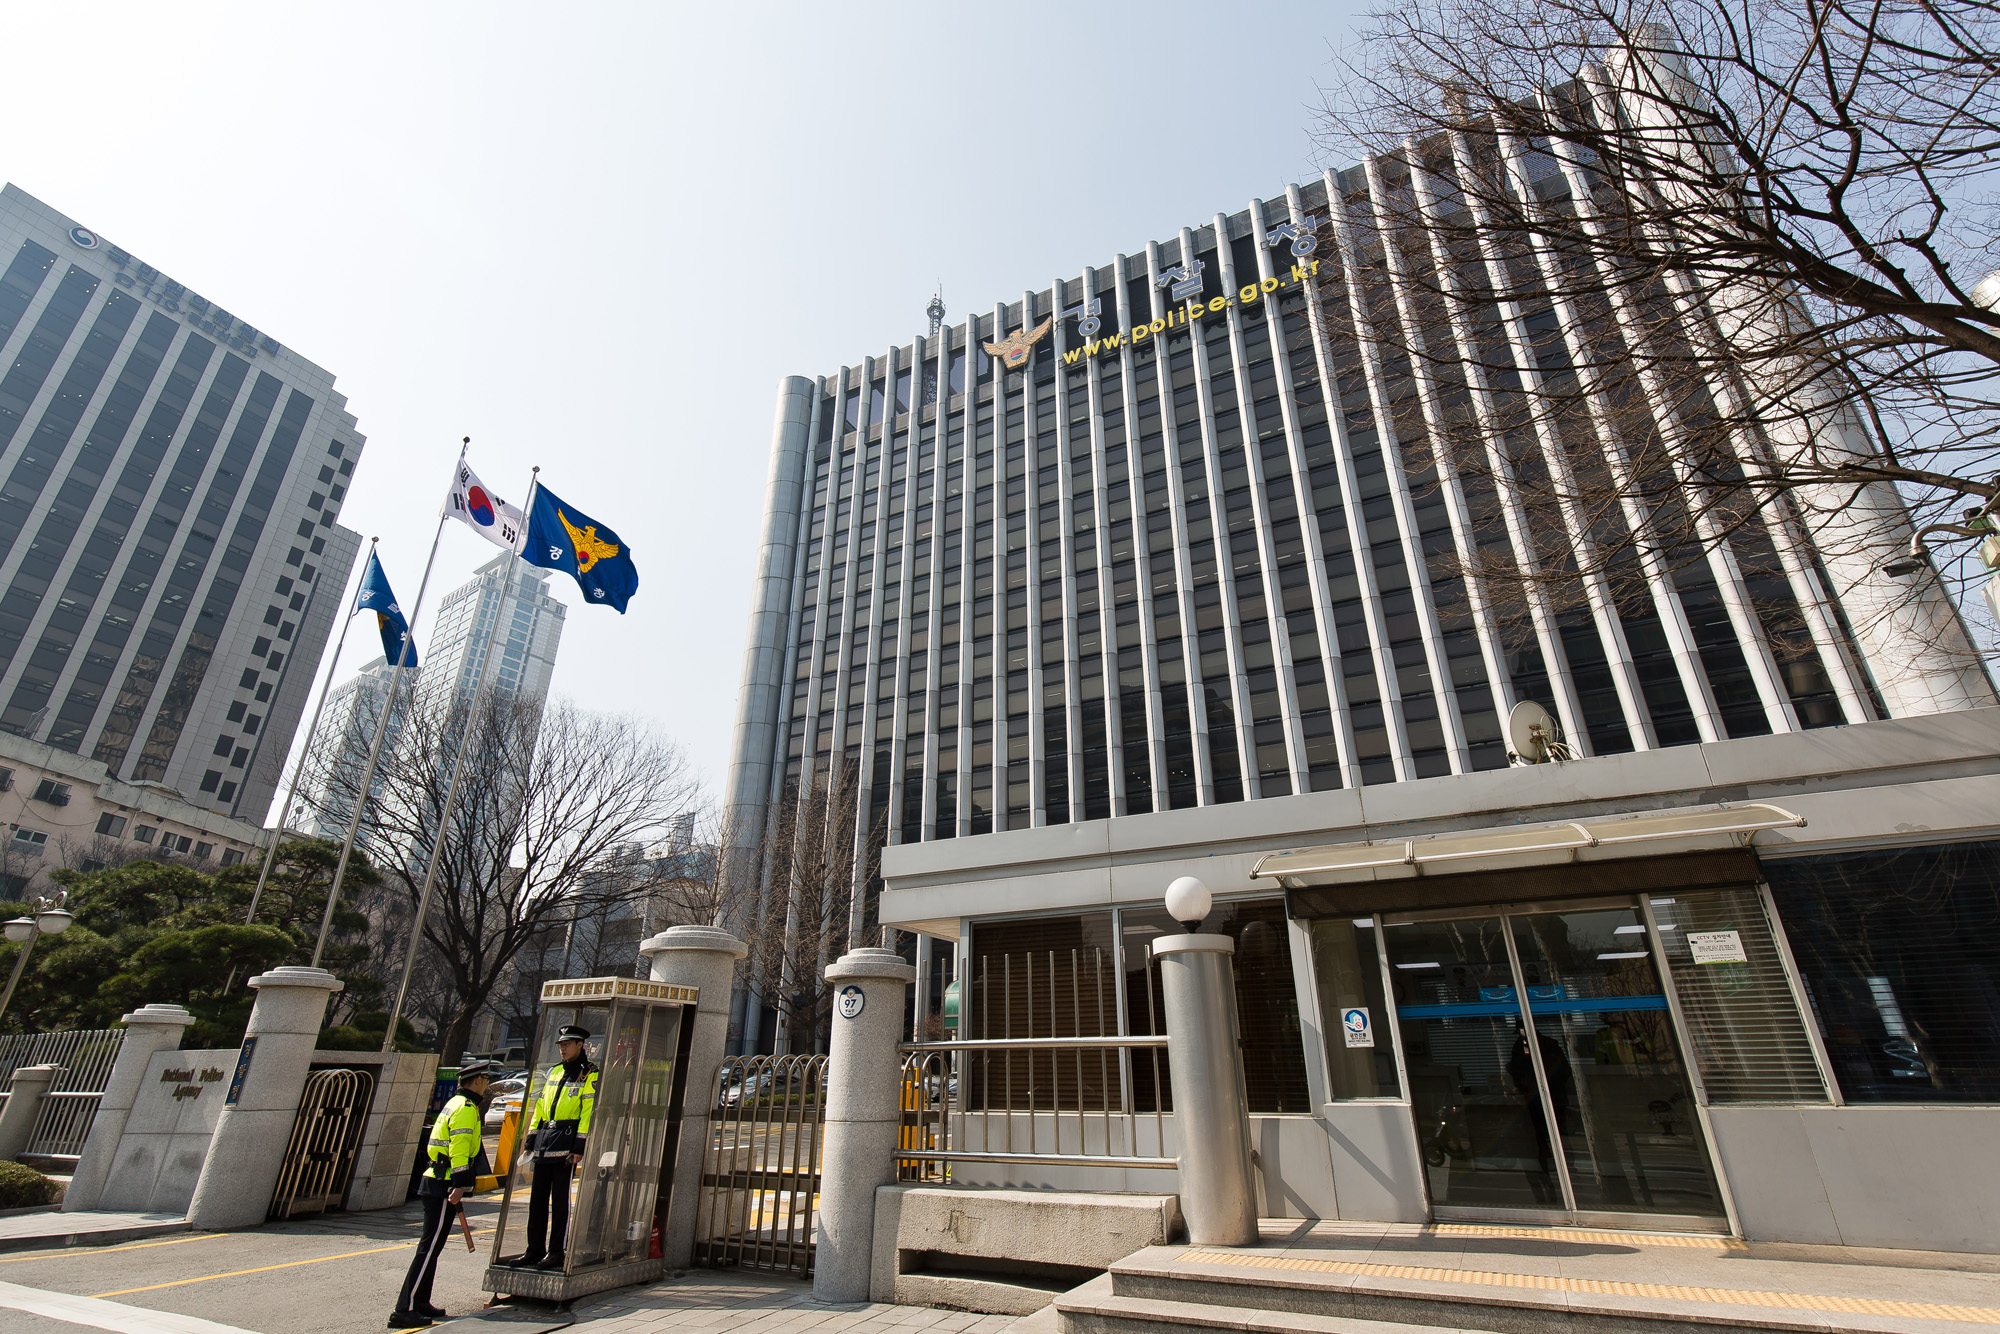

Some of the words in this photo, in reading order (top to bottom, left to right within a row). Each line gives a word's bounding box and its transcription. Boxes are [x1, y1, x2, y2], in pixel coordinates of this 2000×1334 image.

[107, 245, 281, 358] 국민권익위원회
[1060, 215, 1318, 338] 경찰청
[1062, 258, 1320, 365] www.police.go.kr
[844, 999, 857, 1008] 97
[160, 1068, 195, 1083] National
[199, 1066, 225, 1082] Police
[171, 1083, 204, 1102] Agency
